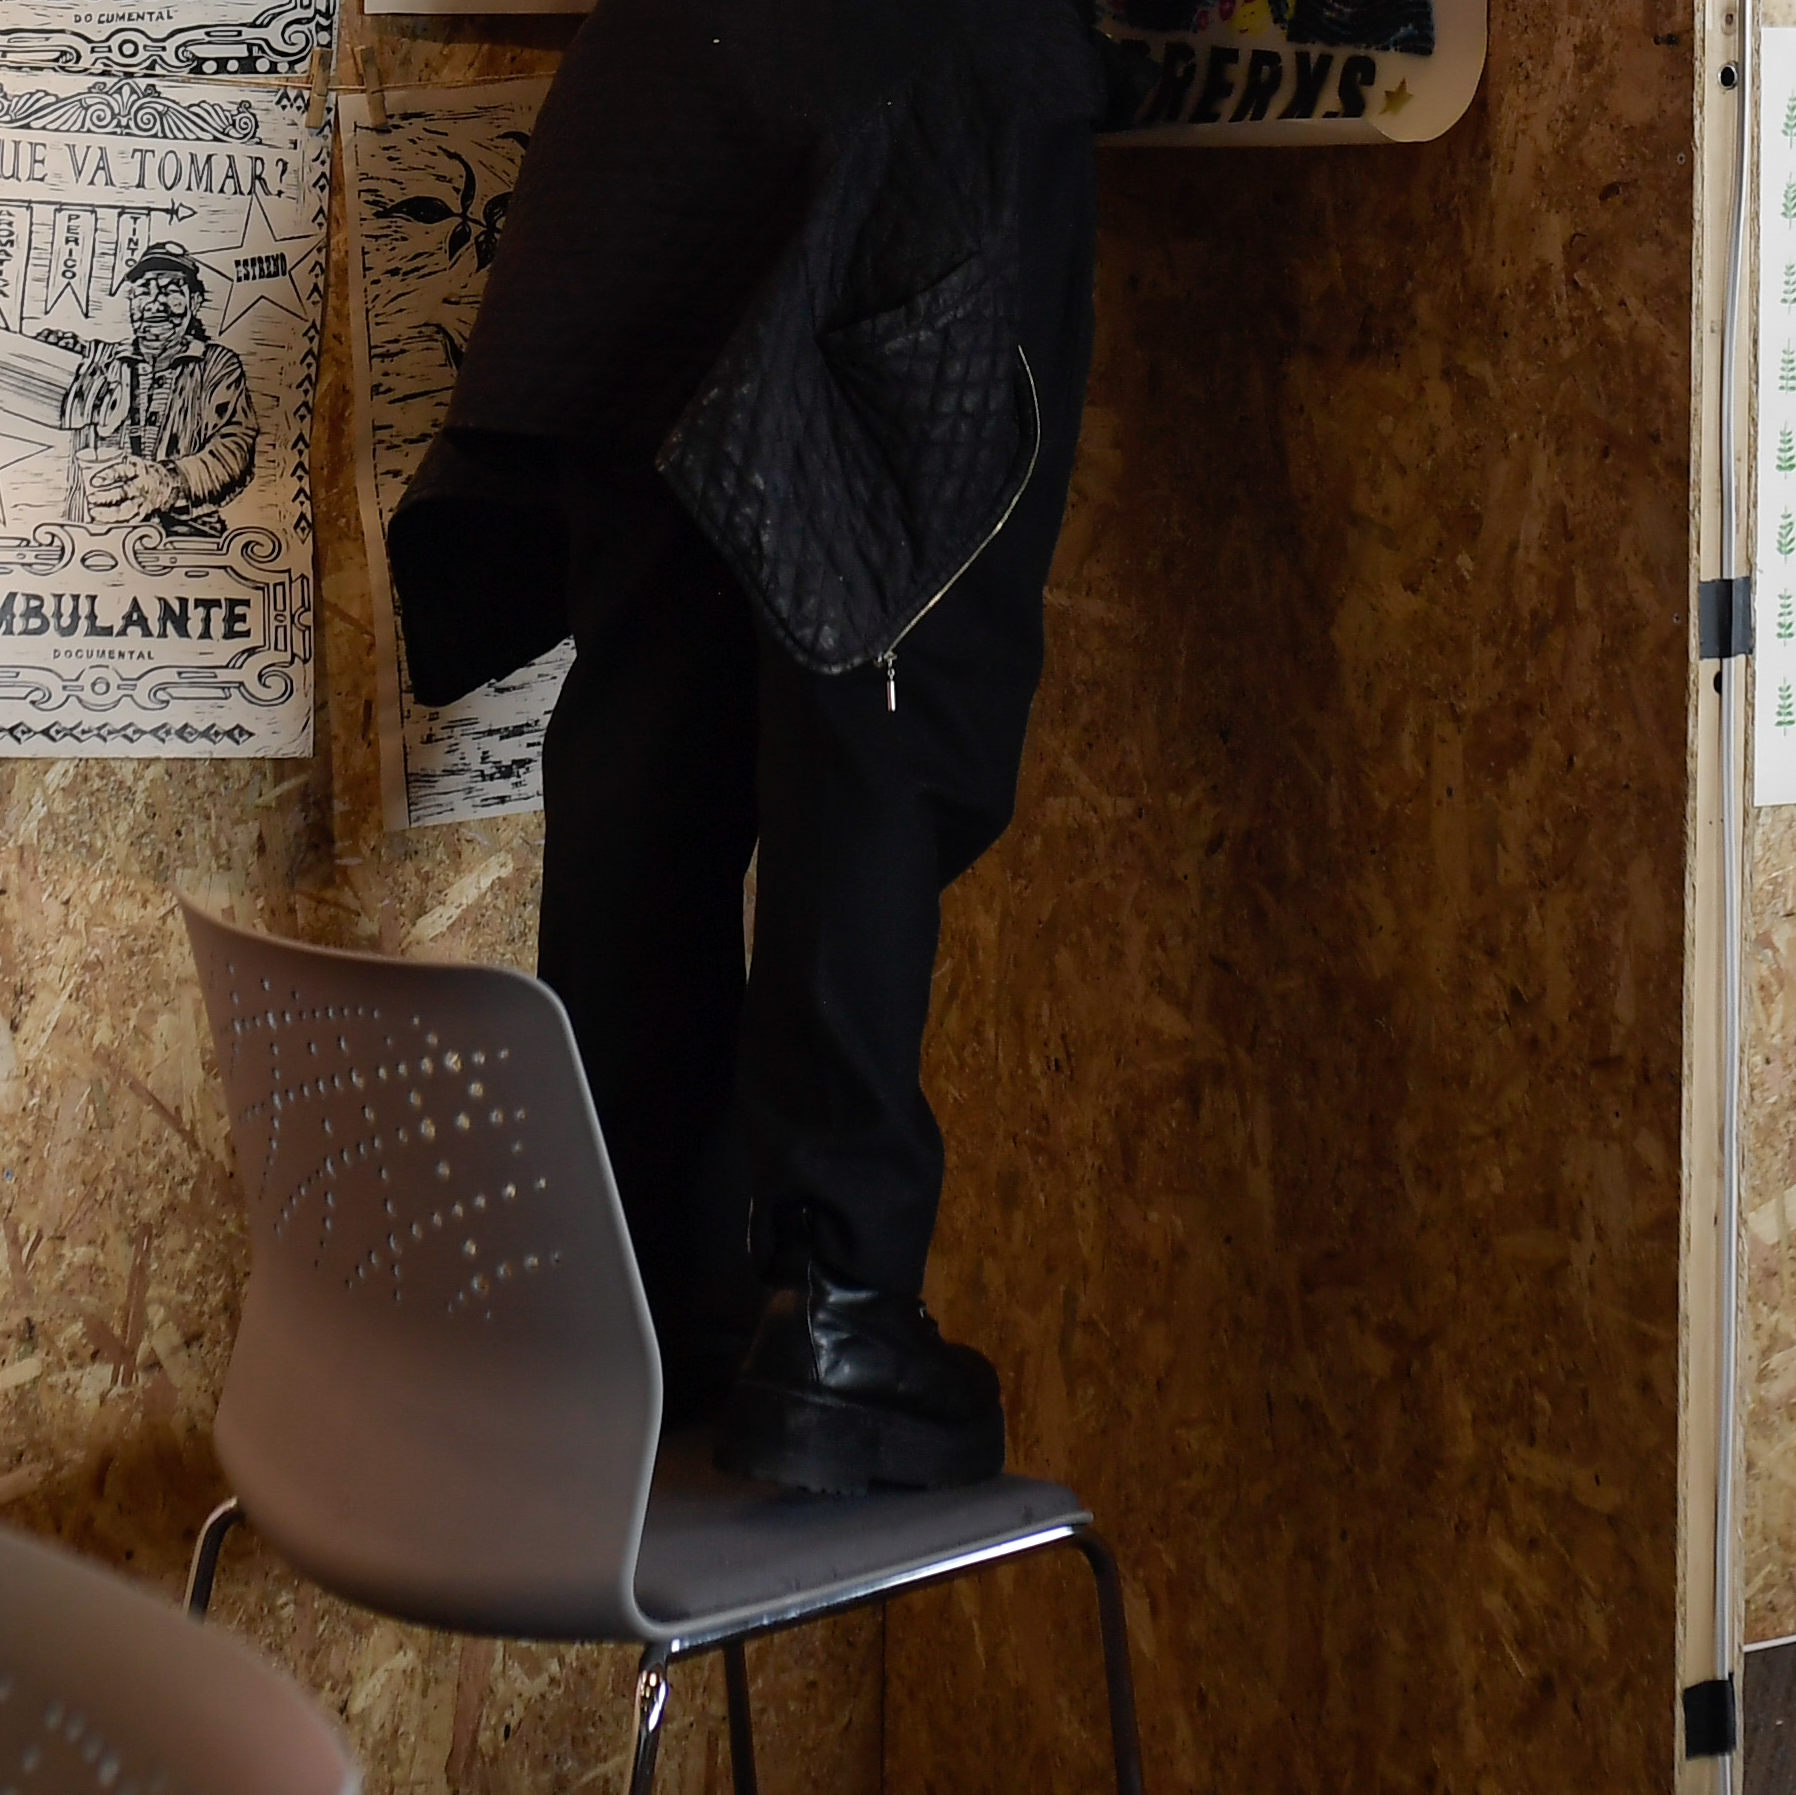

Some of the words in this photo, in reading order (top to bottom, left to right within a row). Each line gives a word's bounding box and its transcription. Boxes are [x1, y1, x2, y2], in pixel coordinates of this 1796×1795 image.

[64, 142, 117, 187] VA
[132, 148, 288, 199] TOMAR?
[61, 213, 79, 281] PERICO
[234, 251, 288, 284] ESTRENO
[52, 647, 156, 662] DOCUMENTAL
